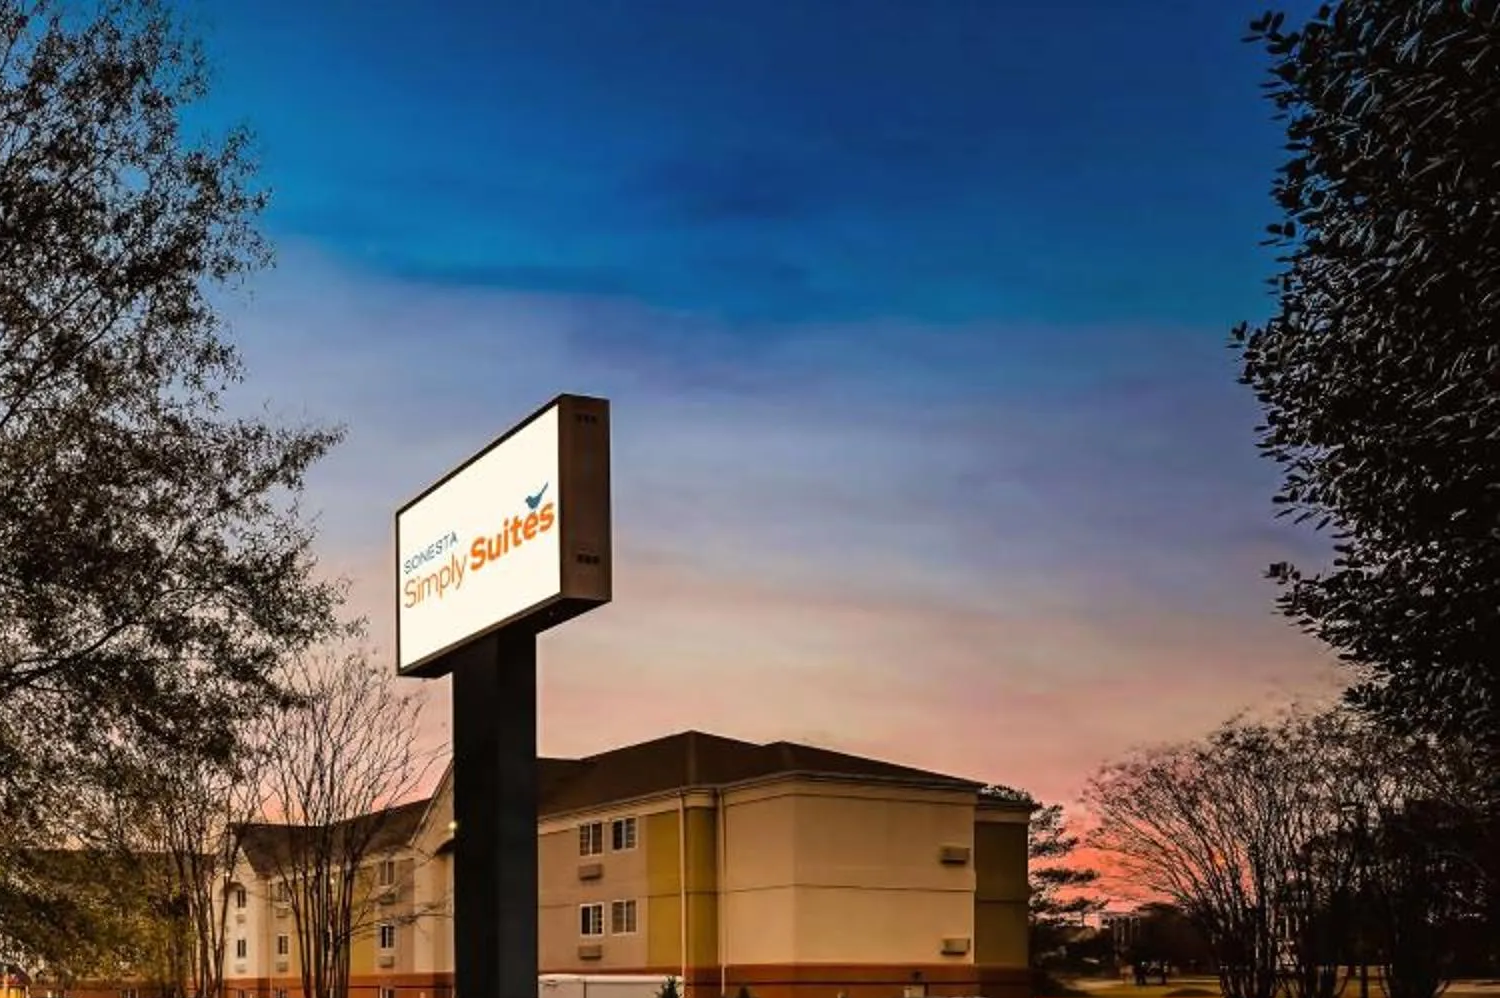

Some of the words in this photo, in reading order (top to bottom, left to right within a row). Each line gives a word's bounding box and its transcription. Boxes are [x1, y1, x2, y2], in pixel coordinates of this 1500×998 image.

[404, 530, 458, 574] SONESTA
[404, 553, 467, 608] Simply
[470, 501, 555, 571] Suites
